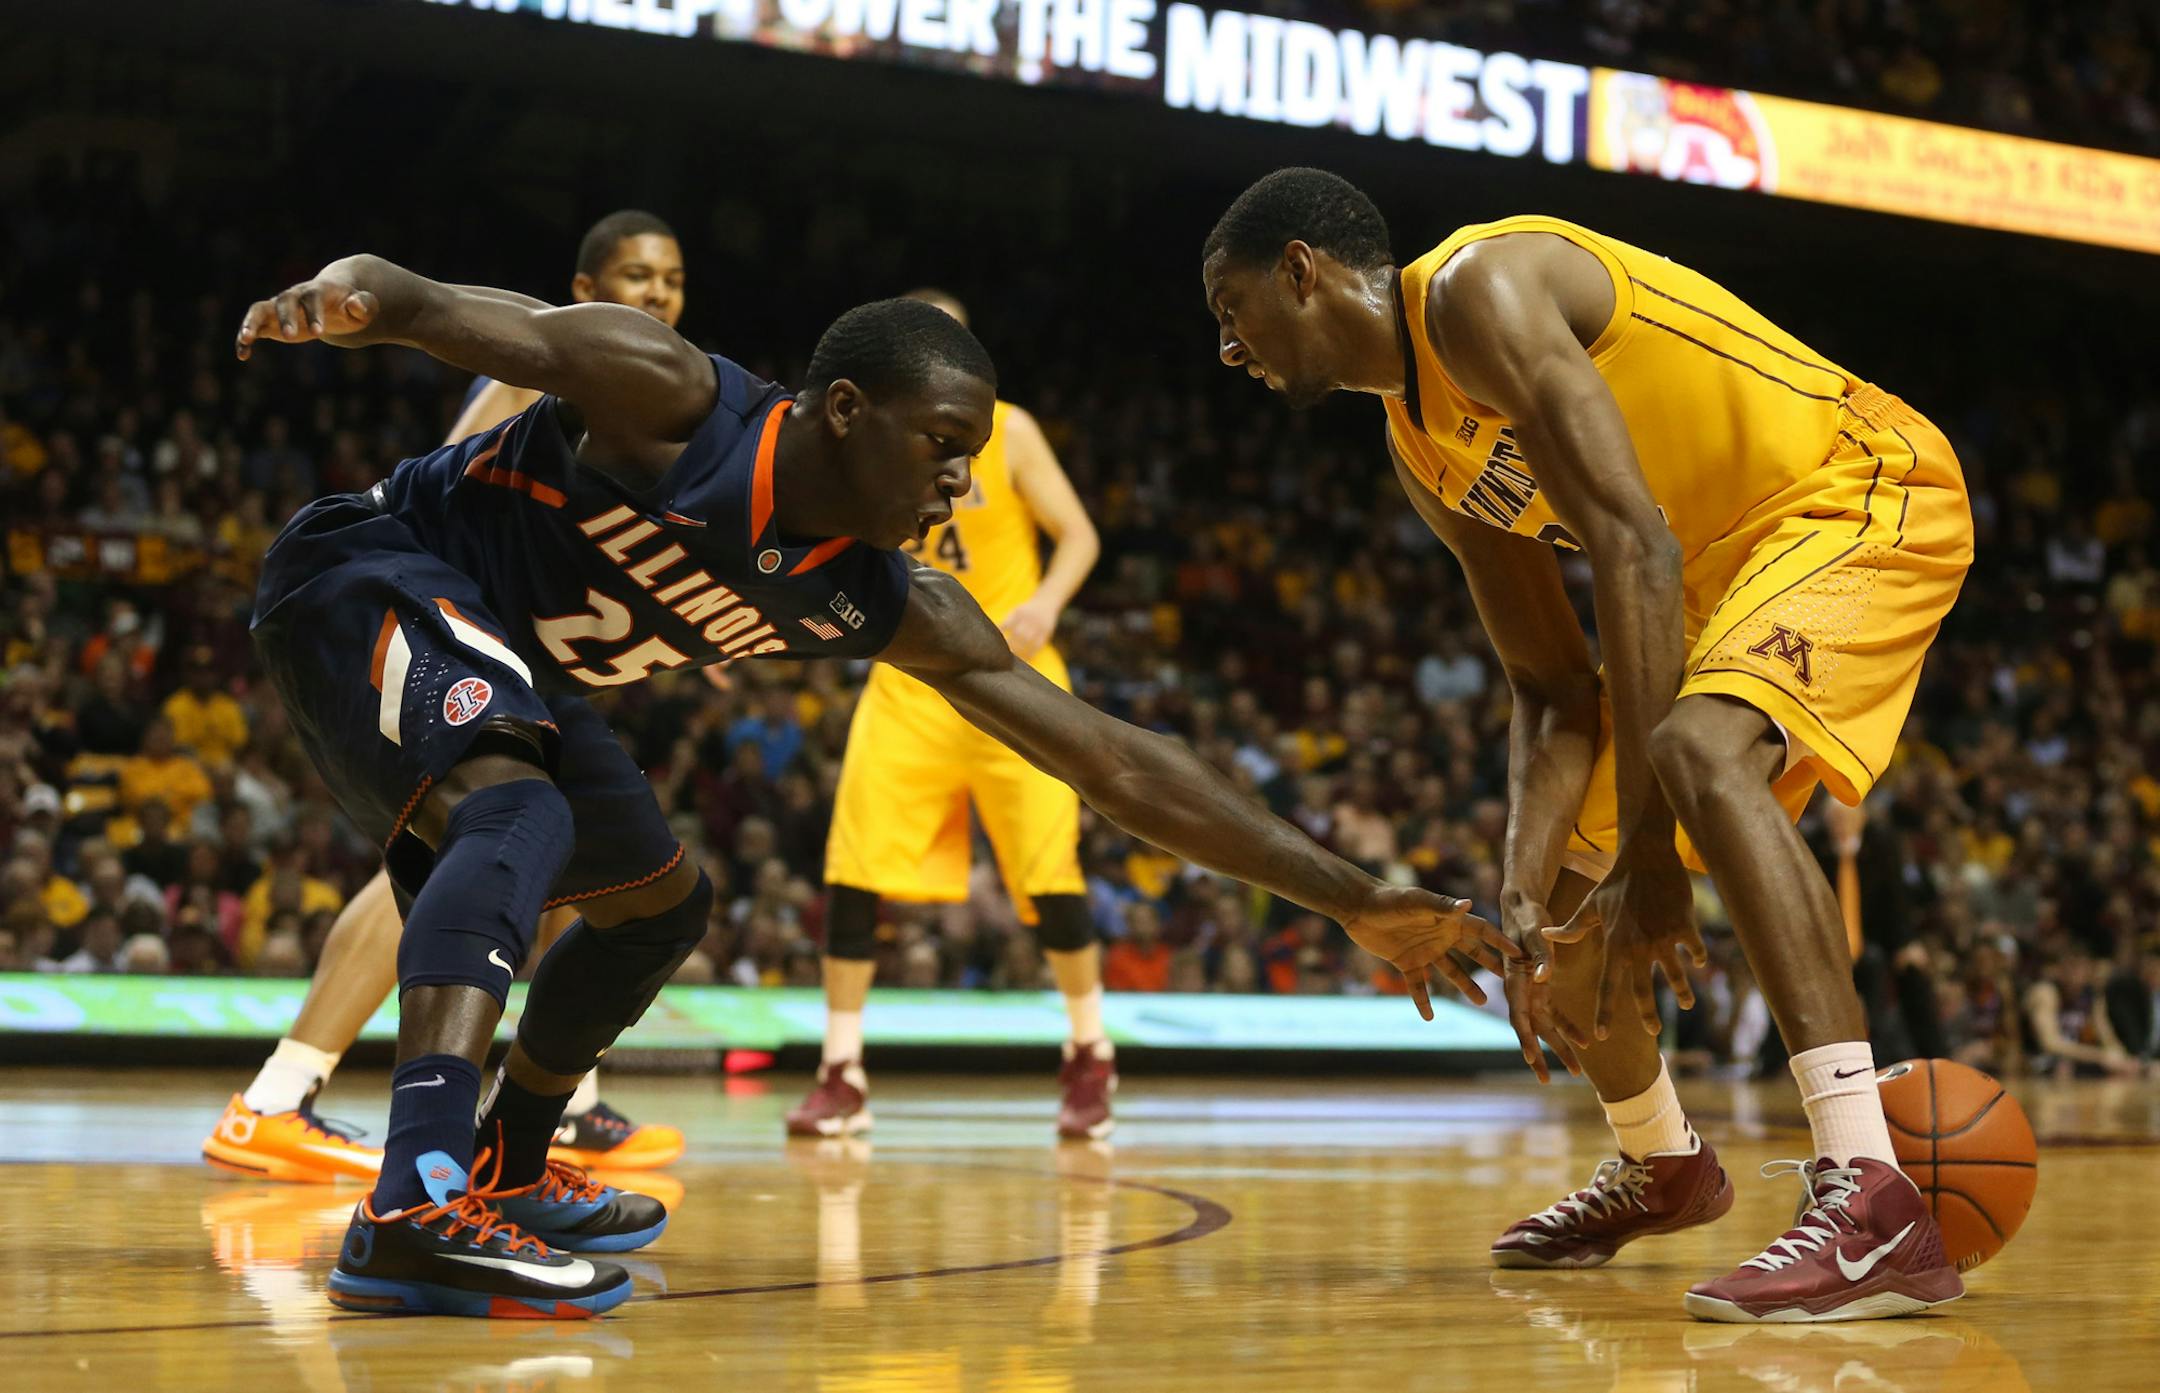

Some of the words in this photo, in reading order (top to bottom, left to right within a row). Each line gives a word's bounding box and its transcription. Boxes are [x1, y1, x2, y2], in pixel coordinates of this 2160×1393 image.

[1018, 0, 1158, 81] THE
[1165, 2, 1590, 164] MIDWEST
[531, 586, 693, 688] 25
[1746, 622, 1814, 687] M
